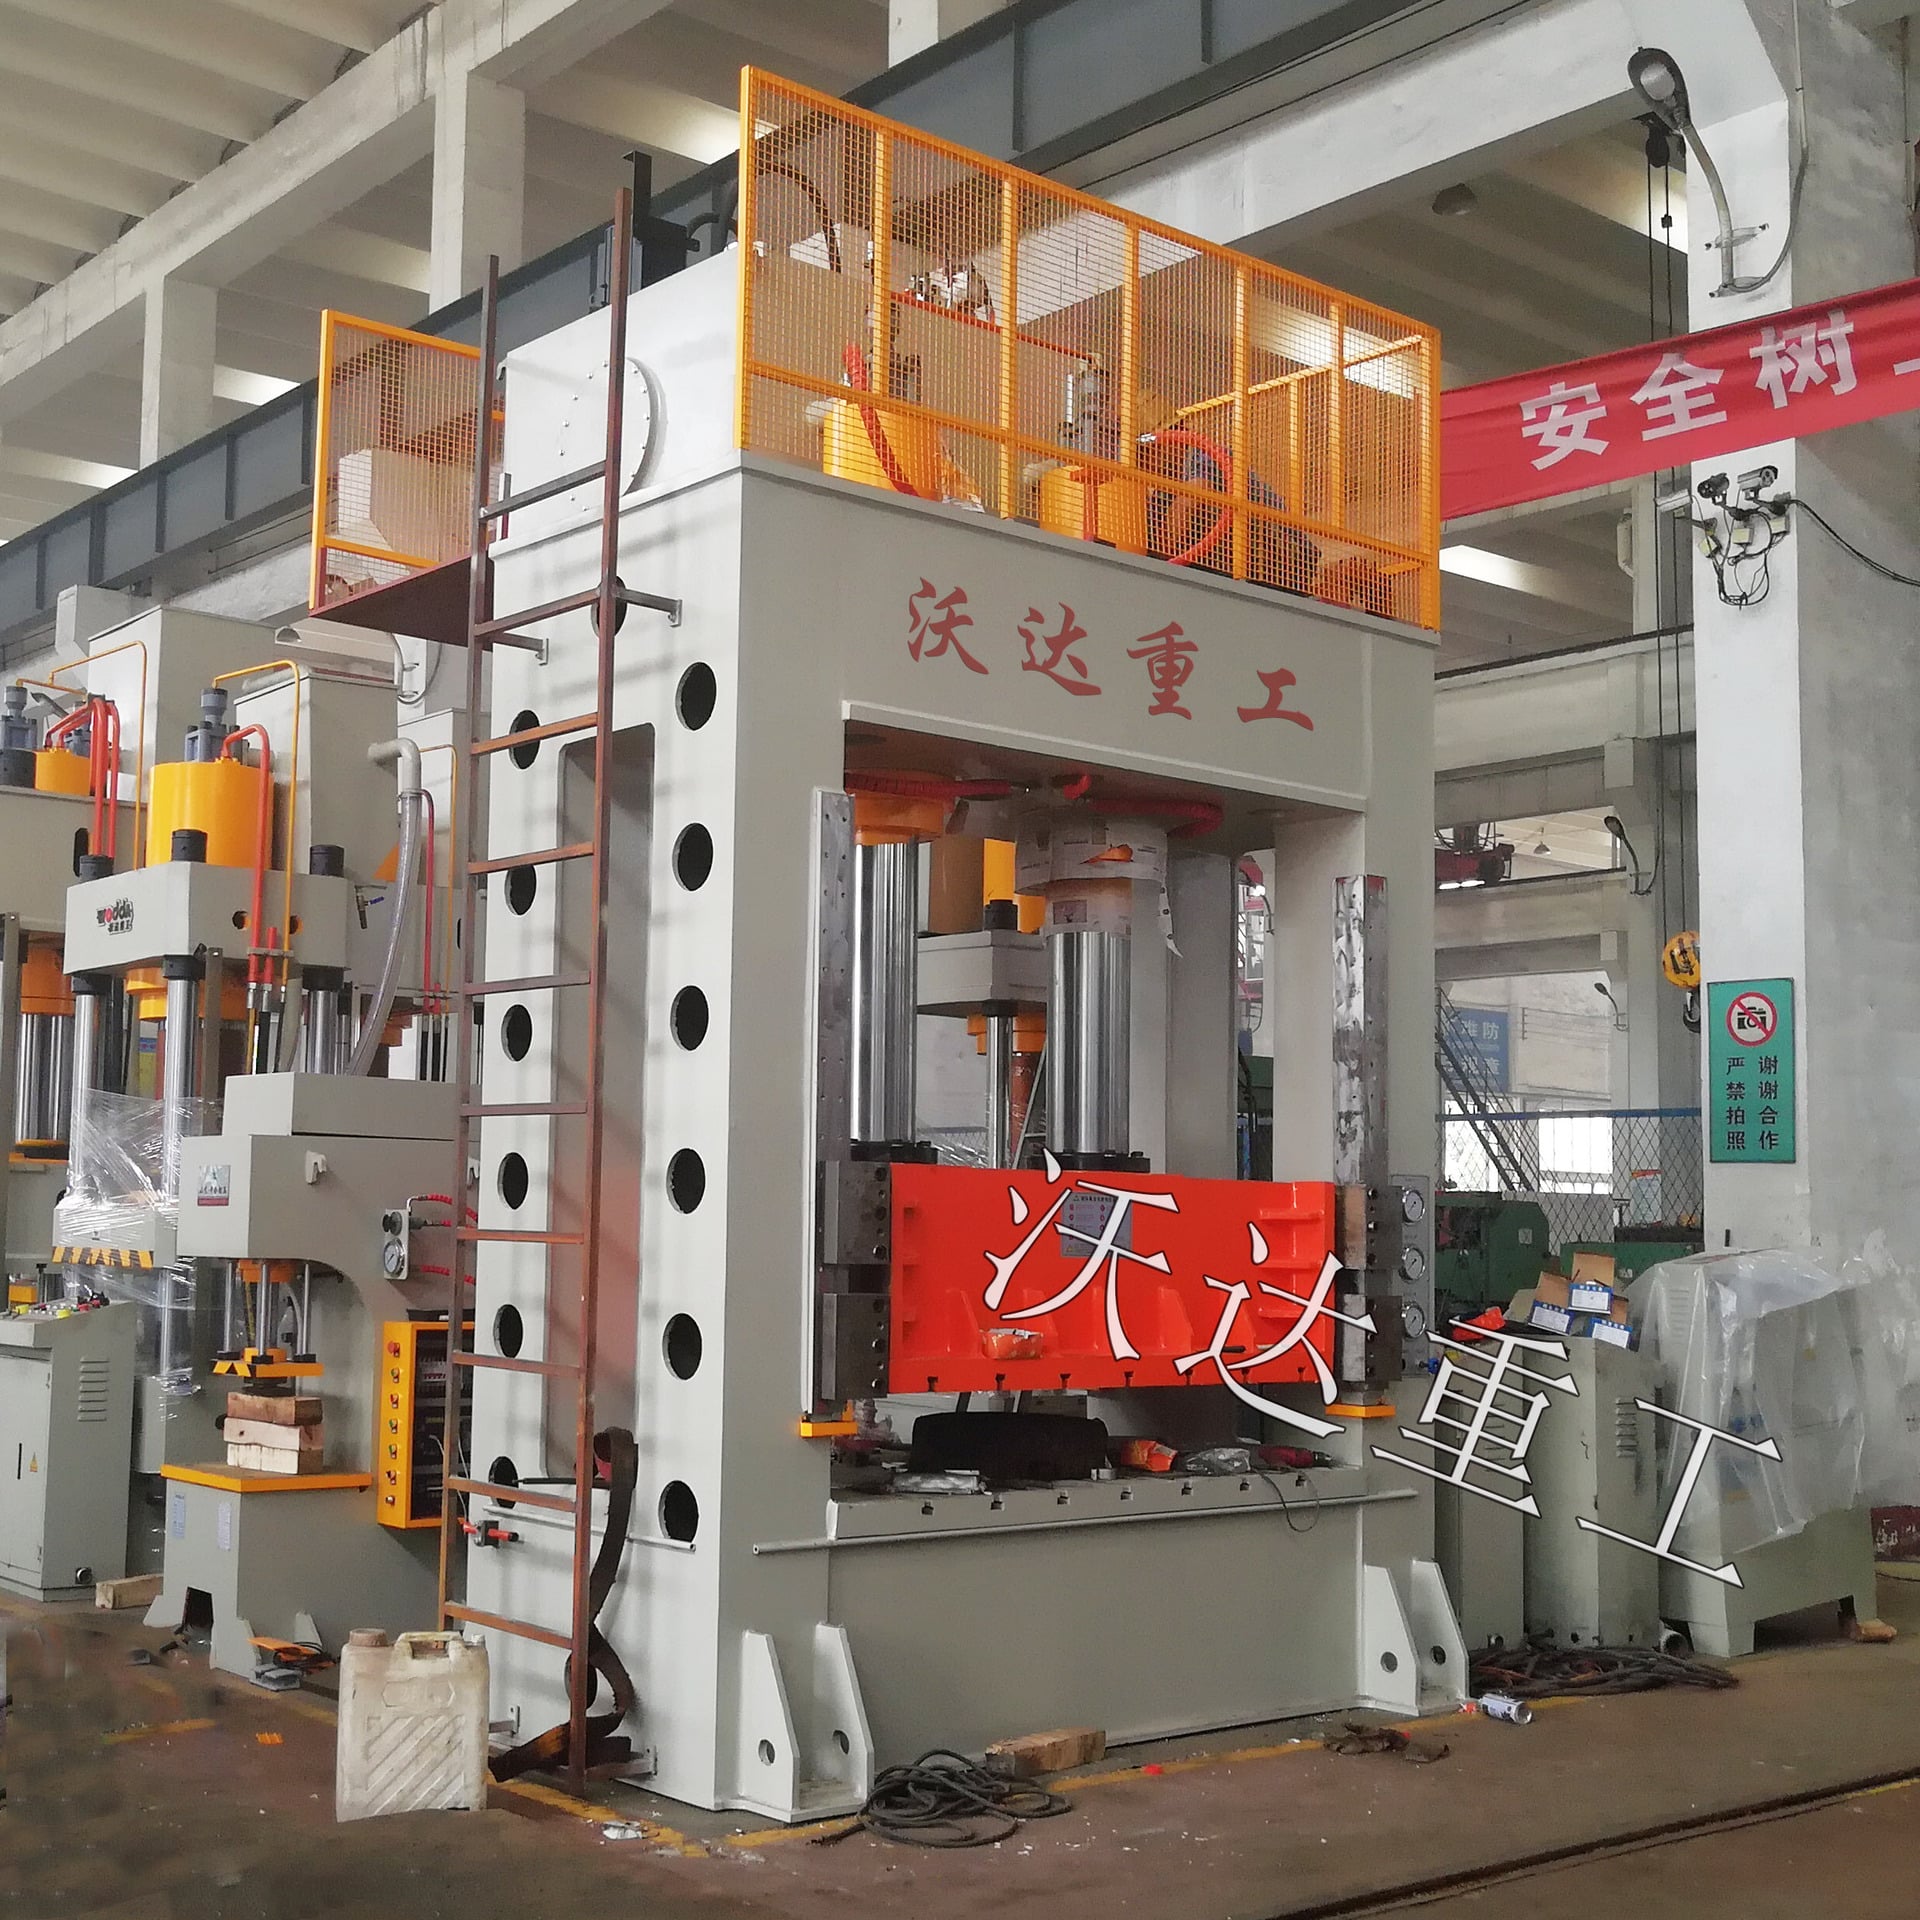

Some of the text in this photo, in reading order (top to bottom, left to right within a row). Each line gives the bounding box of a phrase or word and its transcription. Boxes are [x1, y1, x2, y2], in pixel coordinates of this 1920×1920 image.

[906, 576, 1315, 732] 沃达重工
[1725, 1056, 1747, 1150] 严禁拍照
[1757, 1055, 1780, 1150] 谢谢合作
